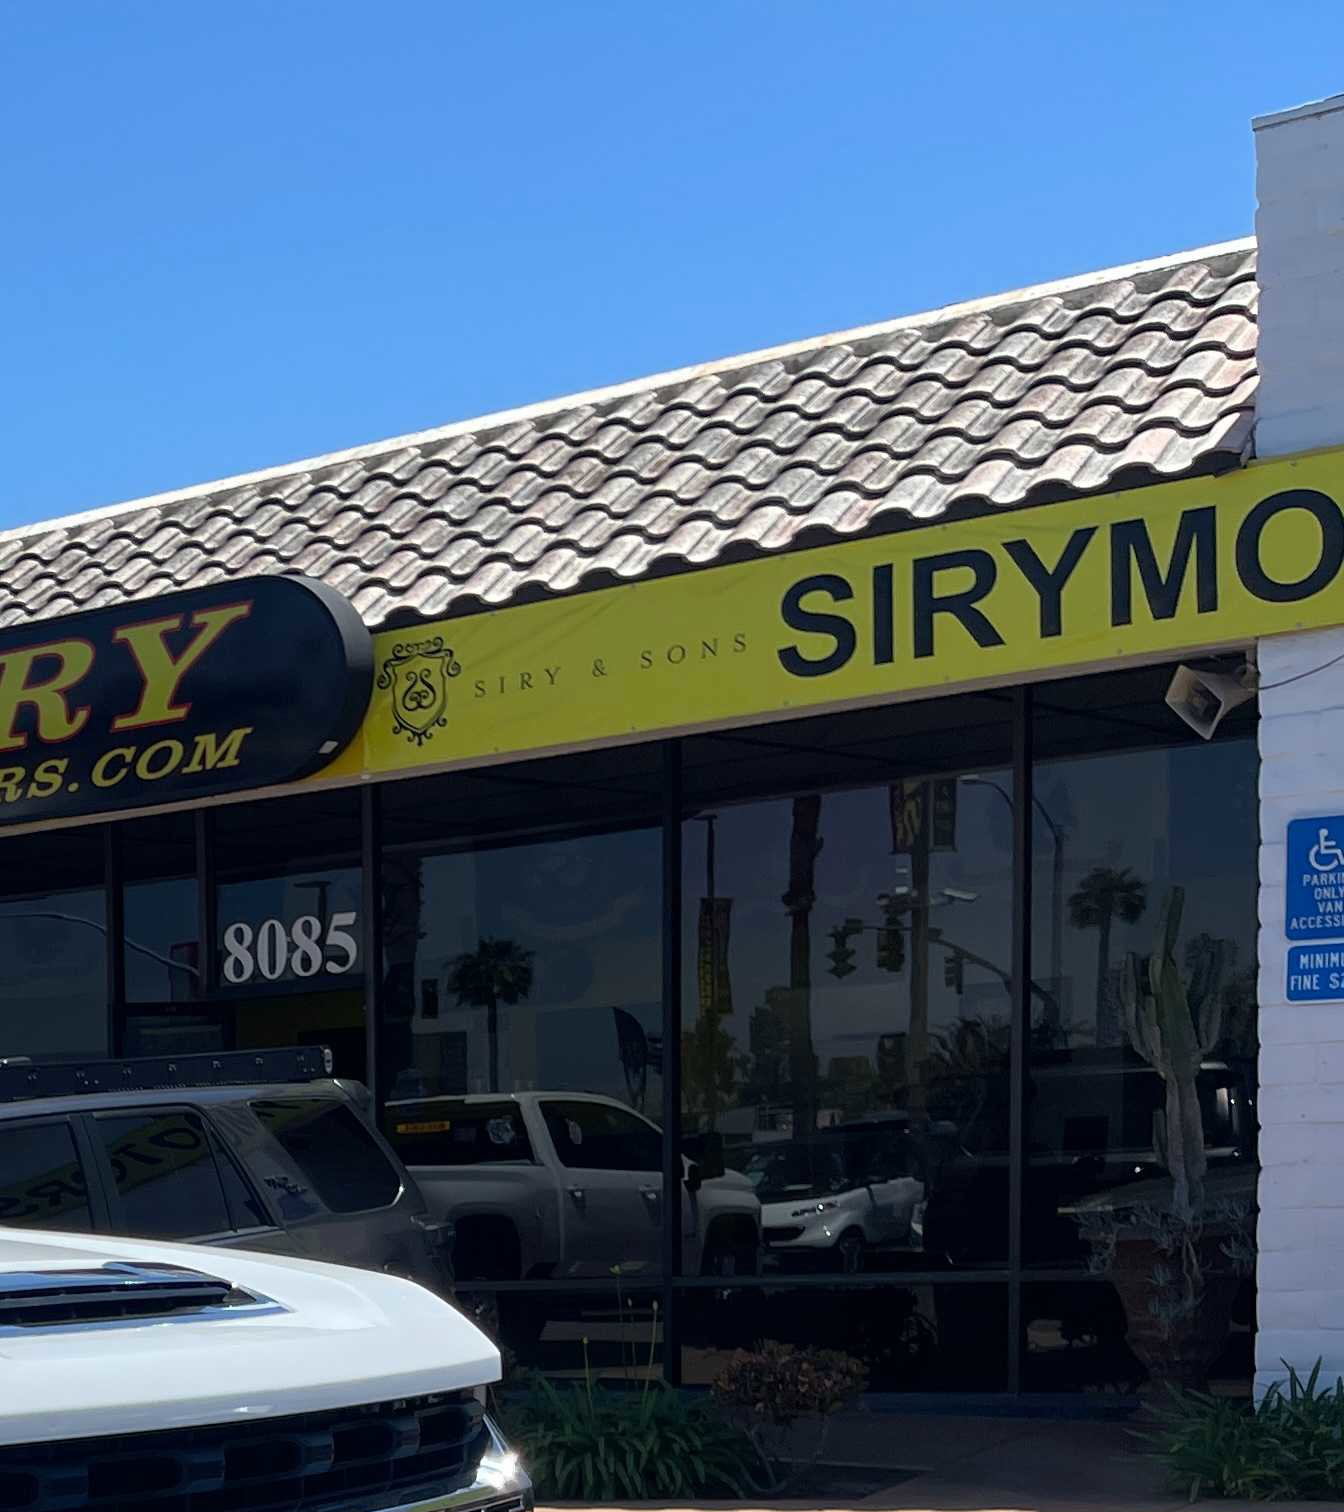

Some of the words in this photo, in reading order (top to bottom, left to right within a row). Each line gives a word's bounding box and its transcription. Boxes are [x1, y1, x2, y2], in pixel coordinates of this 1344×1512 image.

[777, 489, 1344, 679] SIRYMO
[474, 666, 561, 698] SIRY
[591, 658, 607, 678] &
[639, 633, 748, 669] SONS
[1317, 899, 1344, 913] VAN
[223, 911, 358, 983] 8085
[1291, 975, 1320, 991] FINE
